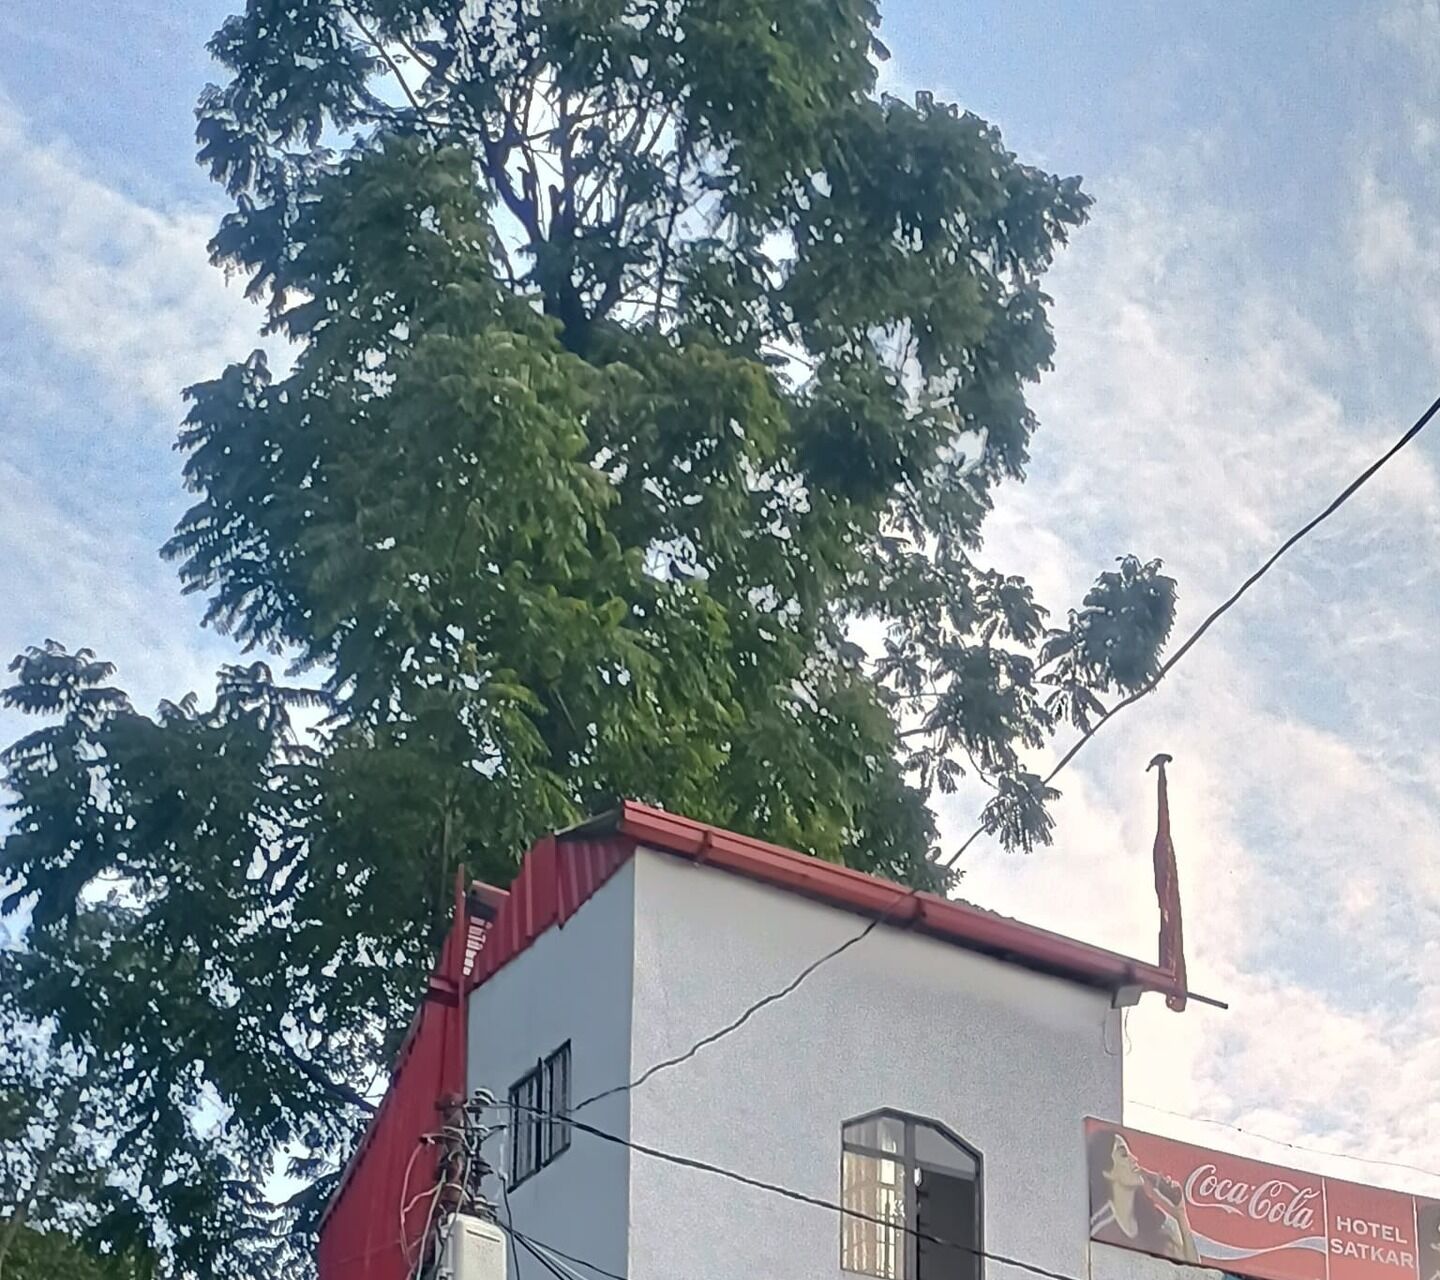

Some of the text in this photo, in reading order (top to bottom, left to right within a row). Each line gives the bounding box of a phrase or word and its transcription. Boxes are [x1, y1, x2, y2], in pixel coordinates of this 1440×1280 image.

[1185, 1164, 1320, 1230] Coca-Cola
[1336, 1215, 1408, 1244] HOTEL
[1330, 1238, 1414, 1269] SATKAR
